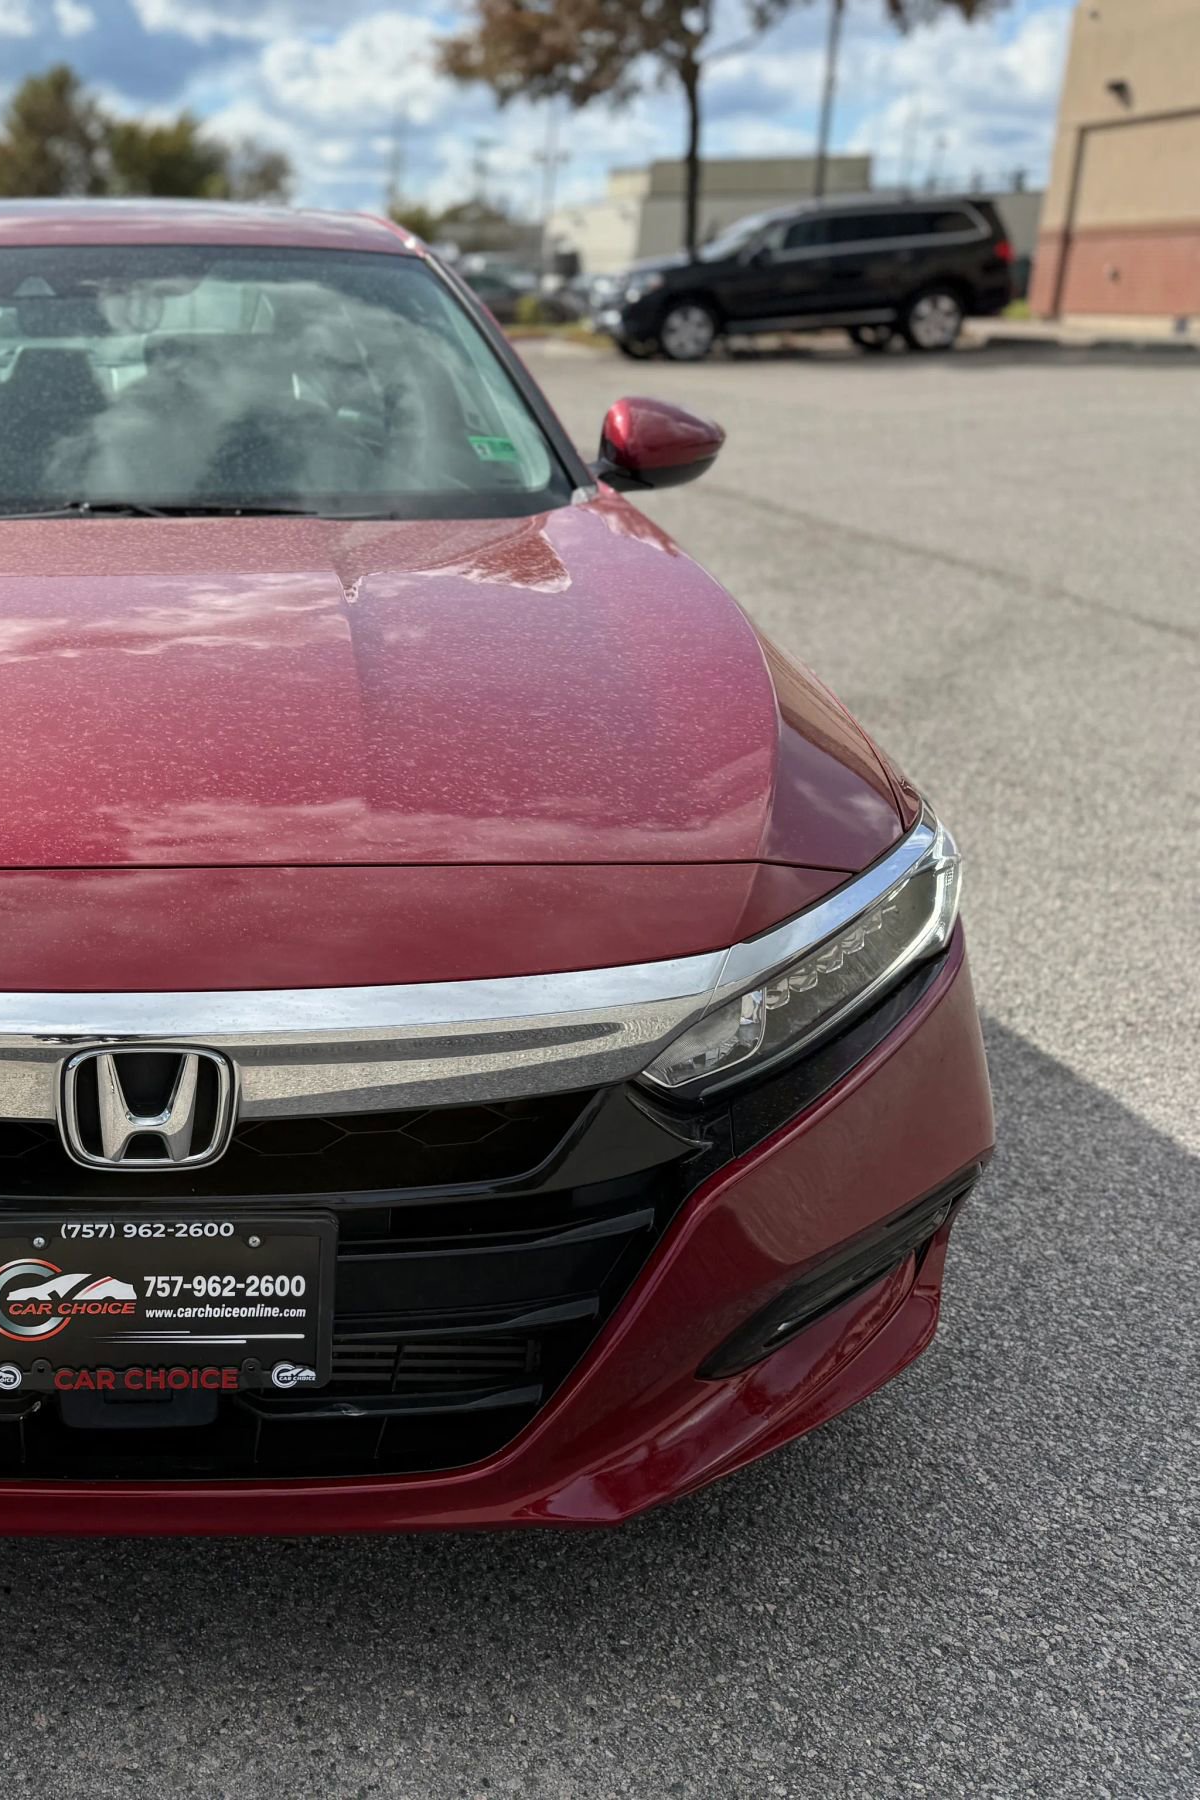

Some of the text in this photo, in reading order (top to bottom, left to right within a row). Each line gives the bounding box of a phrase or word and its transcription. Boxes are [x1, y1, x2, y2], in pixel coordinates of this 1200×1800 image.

[60, 1222, 235, 1239] (757) 962-2600
[143, 1275, 306, 1298] 757-962-2600
[8, 1302, 136, 1315] CAR CHOICE
[145, 1304, 306, 1319] www.carchoiceonline.com
[54, 1367, 240, 1390] CAR CHOICE
